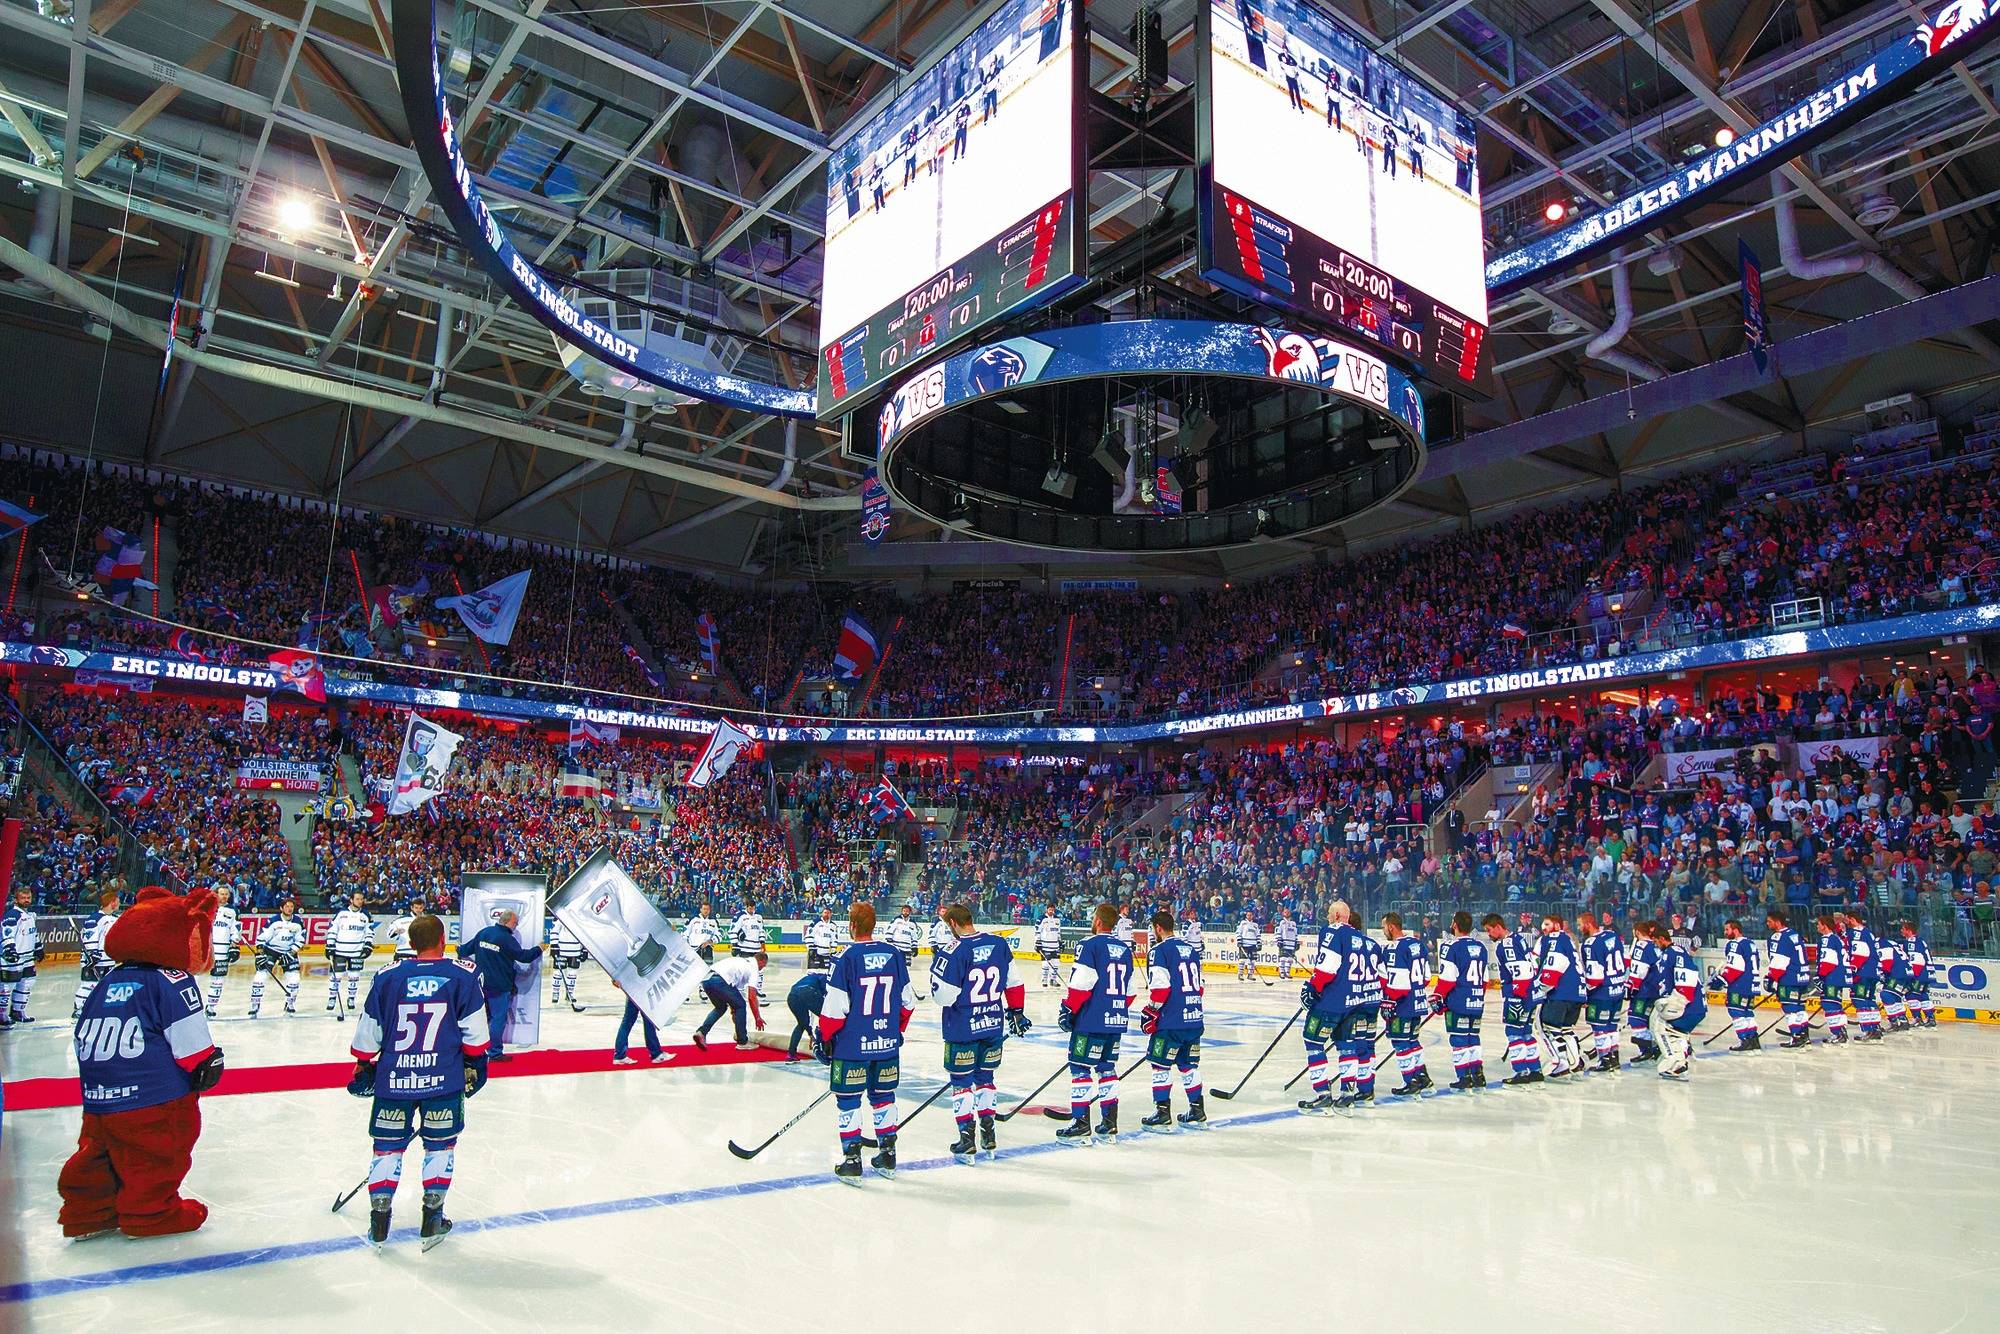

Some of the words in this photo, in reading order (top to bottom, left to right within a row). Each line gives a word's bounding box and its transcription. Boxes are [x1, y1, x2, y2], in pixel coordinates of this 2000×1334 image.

[1582, 181, 1682, 244] ADLER
[1687, 63, 1880, 191] MANNHEIM
[1255, 215, 1288, 238] STRAFZEIT
[1345, 262, 1389, 300] 20:00
[908, 276, 950, 316] 20:00
[511, 253, 538, 294] ERC
[539, 283, 639, 363] INGOLSTADT
[1323, 294, 1334, 312] 0
[1402, 331, 1412, 350] 0
[888, 347, 898, 366] 0
[960, 304, 970, 325] 0
[1345, 352, 1389, 403] VS
[908, 370, 944, 419] VS
[112, 656, 161, 676] ERC
[1446, 680, 1482, 699] ERC
[1485, 660, 1616, 693] INGOLSTADT
[1355, 693, 1379, 712] VS
[575, 706, 630, 726] ADLER
[632, 713, 718, 735] MANNHEIM
[1178, 715, 1223, 734] ADLER
[1224, 704, 1304, 727] MANNHEIM
[847, 729, 876, 741] ERC
[879, 728, 977, 742] INGOLSTADT
[242, 759, 318, 772] VOLLSTRECKER
[250, 769, 310, 780] MANNHEIM
[239, 778, 254, 788] AT
[285, 780, 317, 790] HOME
[1006, 936, 1021, 948] erg
[864, 955, 886, 971] SAP
[972, 947, 991, 962] SAP
[1220, 950, 1240, 961] Elek
[646, 952, 695, 1009] FINALE
[1106, 962, 1127, 996] 17
[1411, 957, 1425, 986] 4
[105, 983, 134, 1002] SAP
[406, 978, 439, 997] SAP
[968, 965, 1001, 1004] 22
[860, 975, 894, 1016] 77
[1930, 992, 1957, 1000] zeuge
[1960, 992, 1991, 1001] GmbH
[395, 1002, 448, 1052] 57
[873, 1018, 888, 1030] GOC
[970, 1014, 1001, 1031] inter
[76, 1016, 146, 1062] UDO
[860, 1035, 897, 1051] inter
[396, 1053, 439, 1067] ARENDT
[954, 1050, 975, 1060] AVIA
[389, 1070, 445, 1089] inter
[846, 1066, 867, 1078] AVIA
[879, 1066, 898, 1077] AVIA
[377, 1109, 406, 1121] AVIA
[424, 1109, 454, 1121] AVIA
